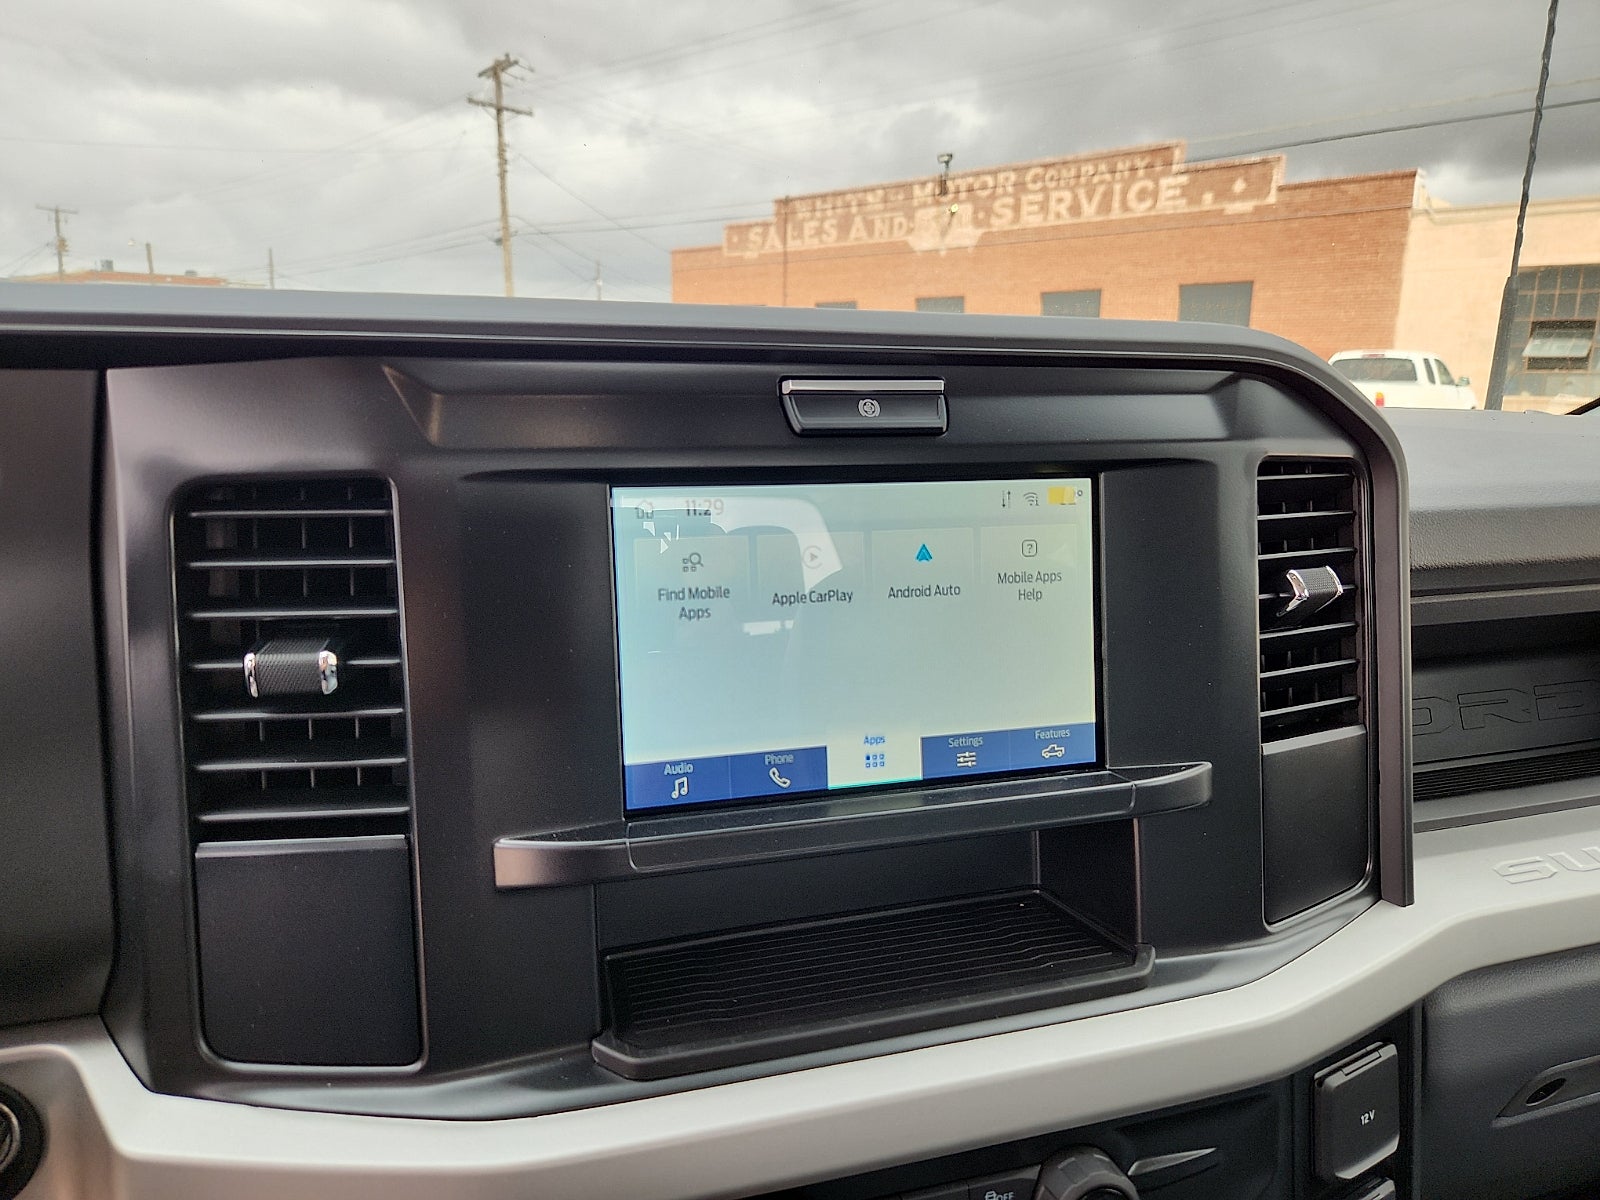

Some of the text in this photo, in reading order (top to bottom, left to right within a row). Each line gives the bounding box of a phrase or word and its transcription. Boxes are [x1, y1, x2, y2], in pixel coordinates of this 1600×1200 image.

[912, 170, 1017, 206] MOTOR
[1025, 156, 1149, 191] COMPANY
[747, 217, 838, 251] SALES
[850, 213, 907, 241] AND
[990, 174, 1191, 226] SERVICE
[685, 499, 724, 516] 11:29
[997, 570, 1063, 585] Mobile Apps
[657, 586, 731, 602] Find Mobile
[772, 588, 853, 607] Apple CarPlay
[888, 583, 961, 599] Android Auto
[1018, 587, 1043, 602] Help
[679, 606, 712, 621] Apps
[863, 735, 886, 747] Apps
[948, 735, 984, 749] Settings
[1034, 728, 1071, 741] Features
[764, 753, 795, 766] Phone
[663, 763, 695, 776] Audio
[1360, 1109, 1376, 1126] 12V
[997, 1191, 1015, 1200] OFF
